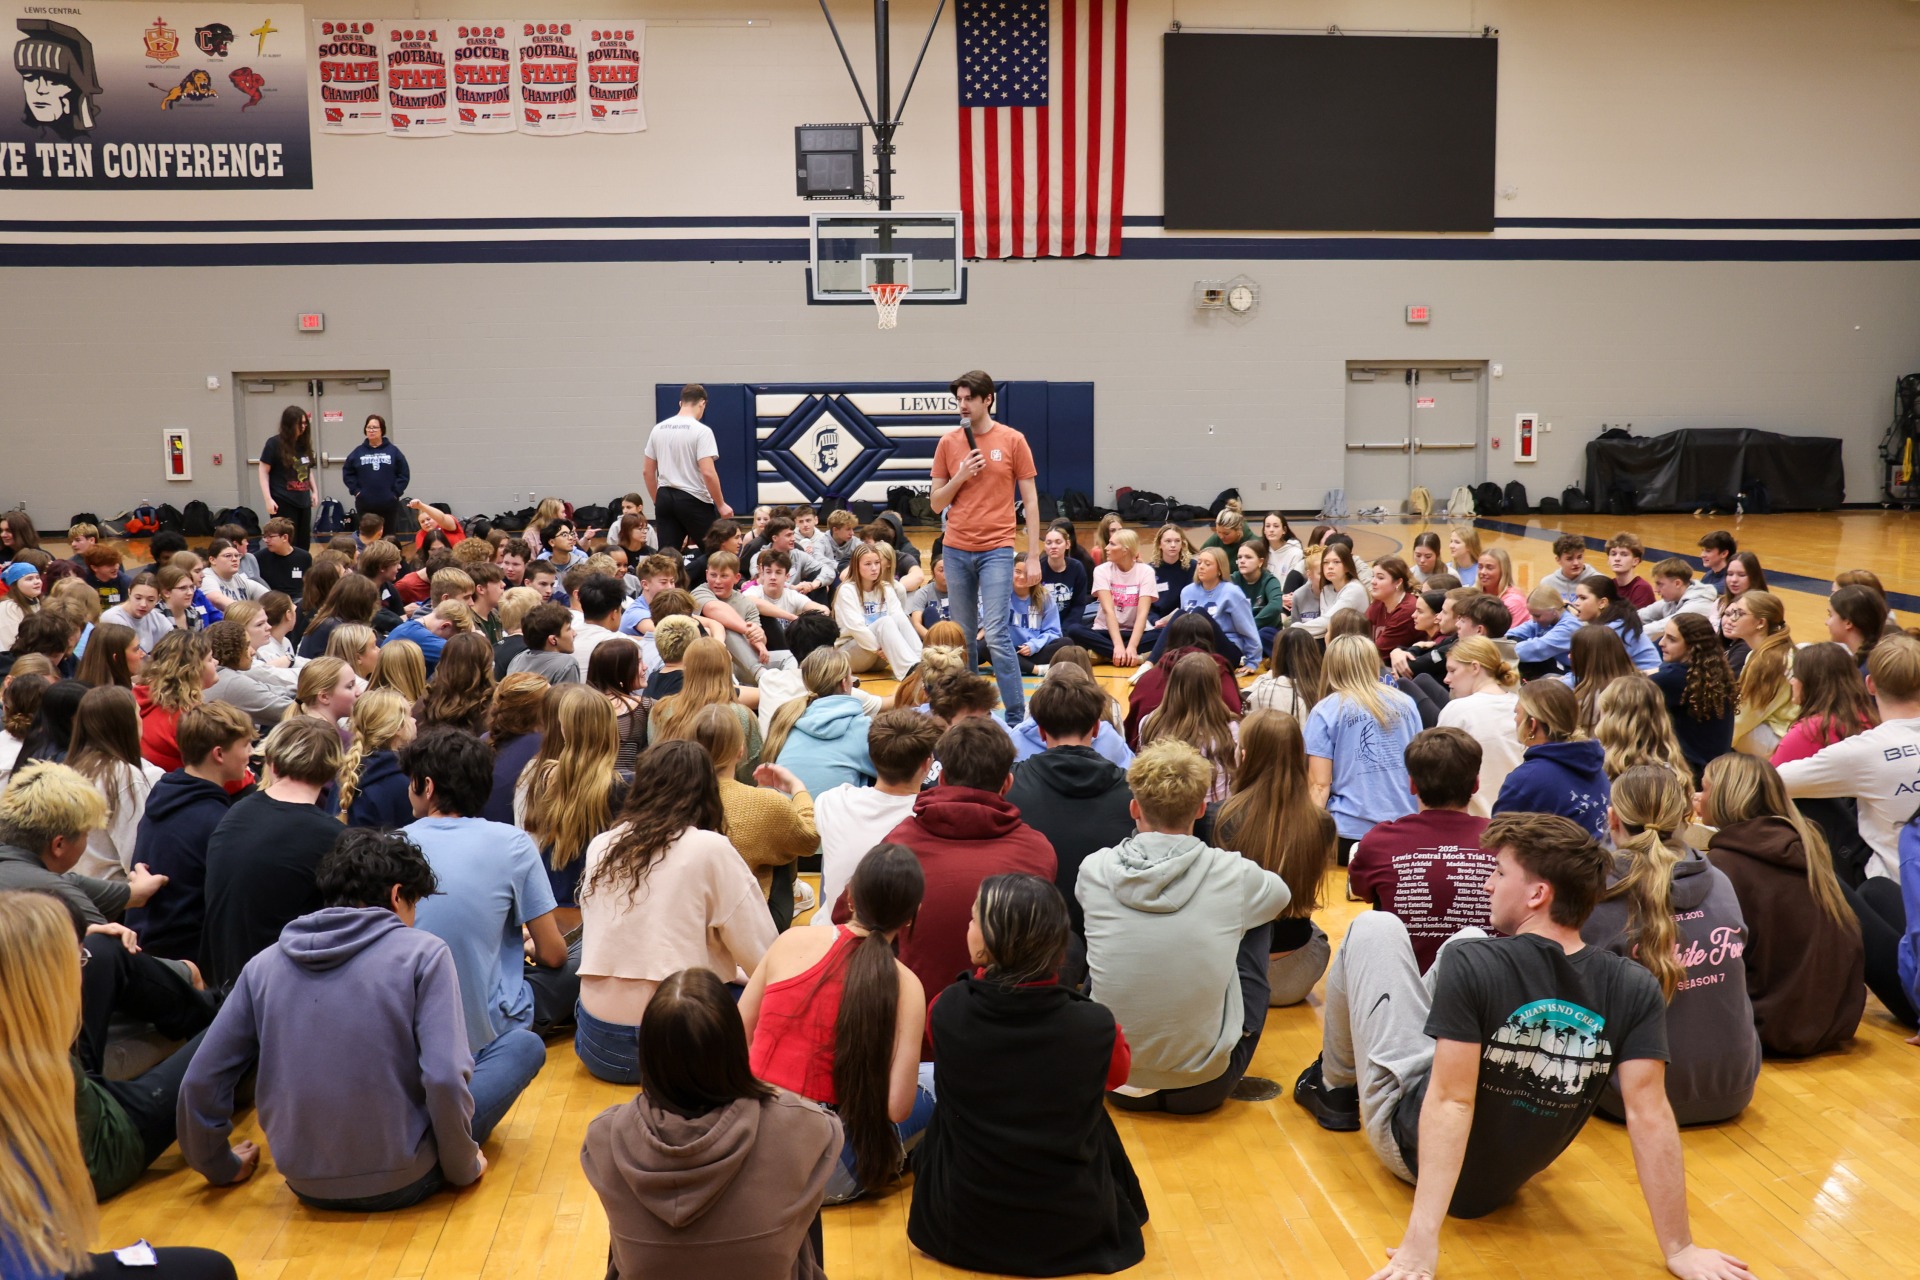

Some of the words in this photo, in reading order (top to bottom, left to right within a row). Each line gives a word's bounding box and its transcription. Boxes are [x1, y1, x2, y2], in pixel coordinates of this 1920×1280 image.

[48, 7, 82, 15] CENTRAL
[322, 22, 374, 35] 2019
[390, 30, 438, 42] 2021
[458, 26, 505, 38] 2022
[523, 24, 571, 36] 2023
[591, 30, 635, 41] 2025
[333, 34, 353, 42] CLASS
[319, 42, 378, 58] SOCCER
[455, 46, 509, 62] SOCCER
[519, 45, 577, 62] FOOTBALL
[587, 48, 640, 64] BOWLING
[387, 50, 445, 68] FOOTBALL
[320, 61, 379, 83] STATE
[388, 69, 447, 90] STATE
[454, 64, 510, 85] STATE
[521, 63, 578, 84] STATE
[588, 65, 639, 85] STATE
[321, 83, 380, 103] CHAMPION
[389, 90, 447, 109] CHAMPION
[456, 85, 510, 104] CHAMPION
[522, 84, 577, 104] CHAMPION
[589, 84, 639, 101] CHAMPION
[0, 143, 28, 177] YE
[35, 143, 93, 178] TEN
[104, 143, 284, 178] CONFERENCE
[303, 315, 319, 327] EXIT
[900, 397, 958, 411] LEWIS
[1347, 713, 1367, 728] GIRLS
[1883, 744, 1920, 761] BE
[1392, 854, 1412, 863] Lewis
[1467, 853, 1485, 861] Trial
[1486, 854, 1496, 862] Te
[1476, 862, 1497, 870] Heathe
[1471, 888, 1490, 896] O'Brie
[1452, 902, 1474, 910] Sydney
[1677, 974, 1718, 991] SEASON
[1719, 973, 1725, 982] 7
[1482, 1083, 1512, 1096] ISLAND
[1536, 1098, 1557, 1108] SURF
[1512, 1099, 1537, 1114] SINCE
